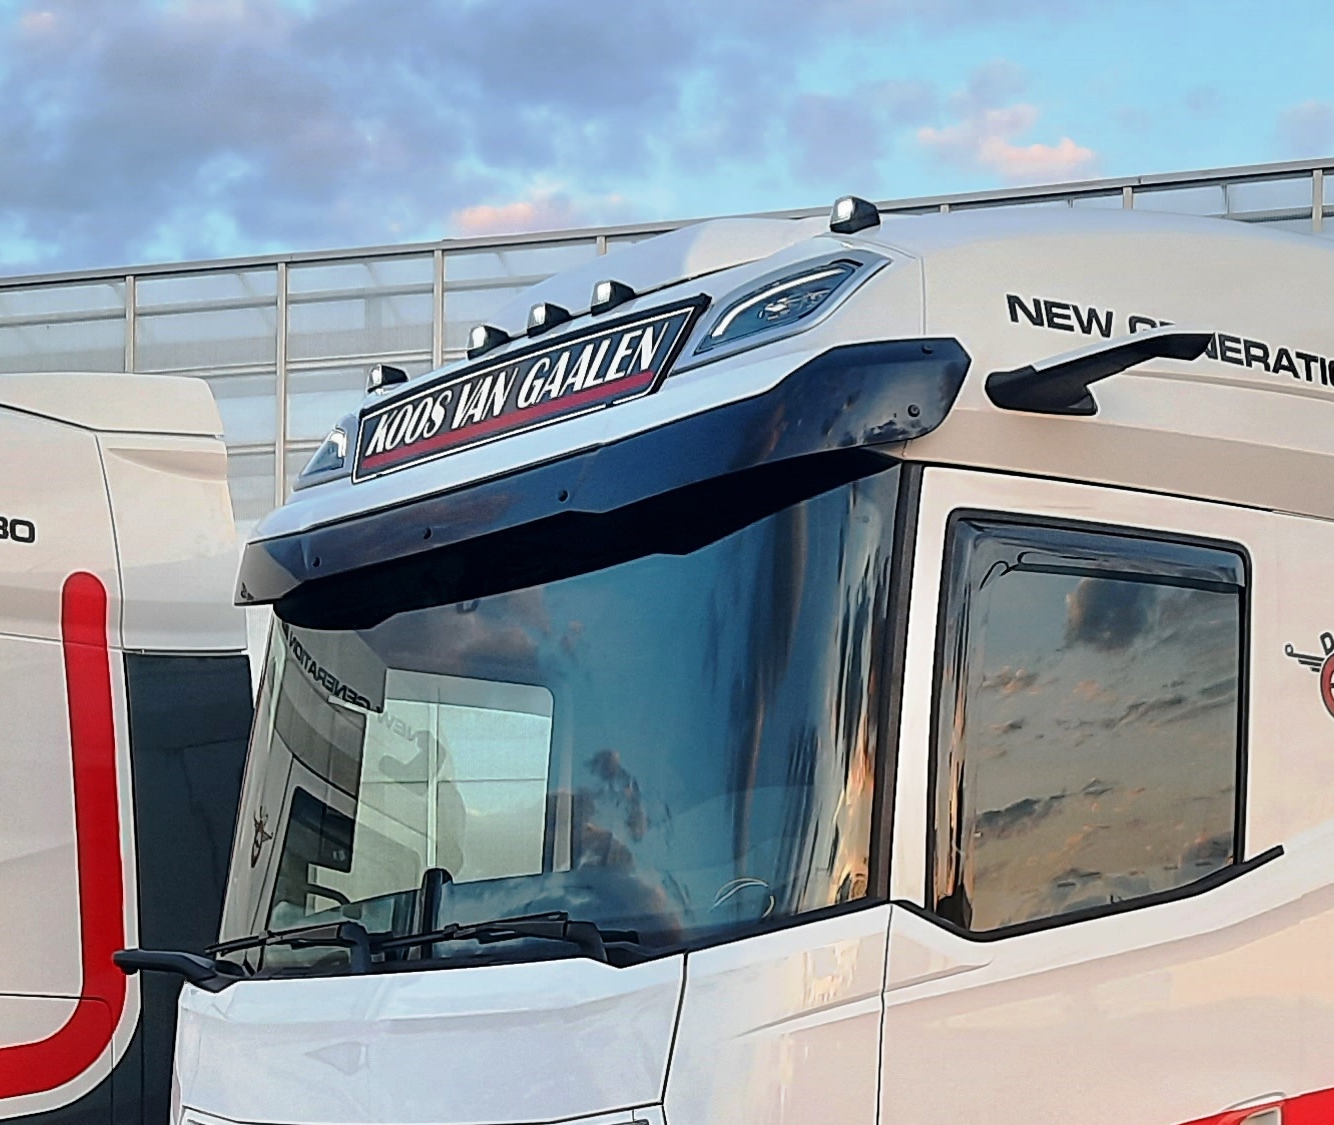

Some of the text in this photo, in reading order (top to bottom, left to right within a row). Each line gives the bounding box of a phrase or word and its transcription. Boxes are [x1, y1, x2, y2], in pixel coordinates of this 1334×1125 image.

[1006, 293, 1113, 338] NEW
[365, 321, 670, 457] KOOS VAN GAALEN
